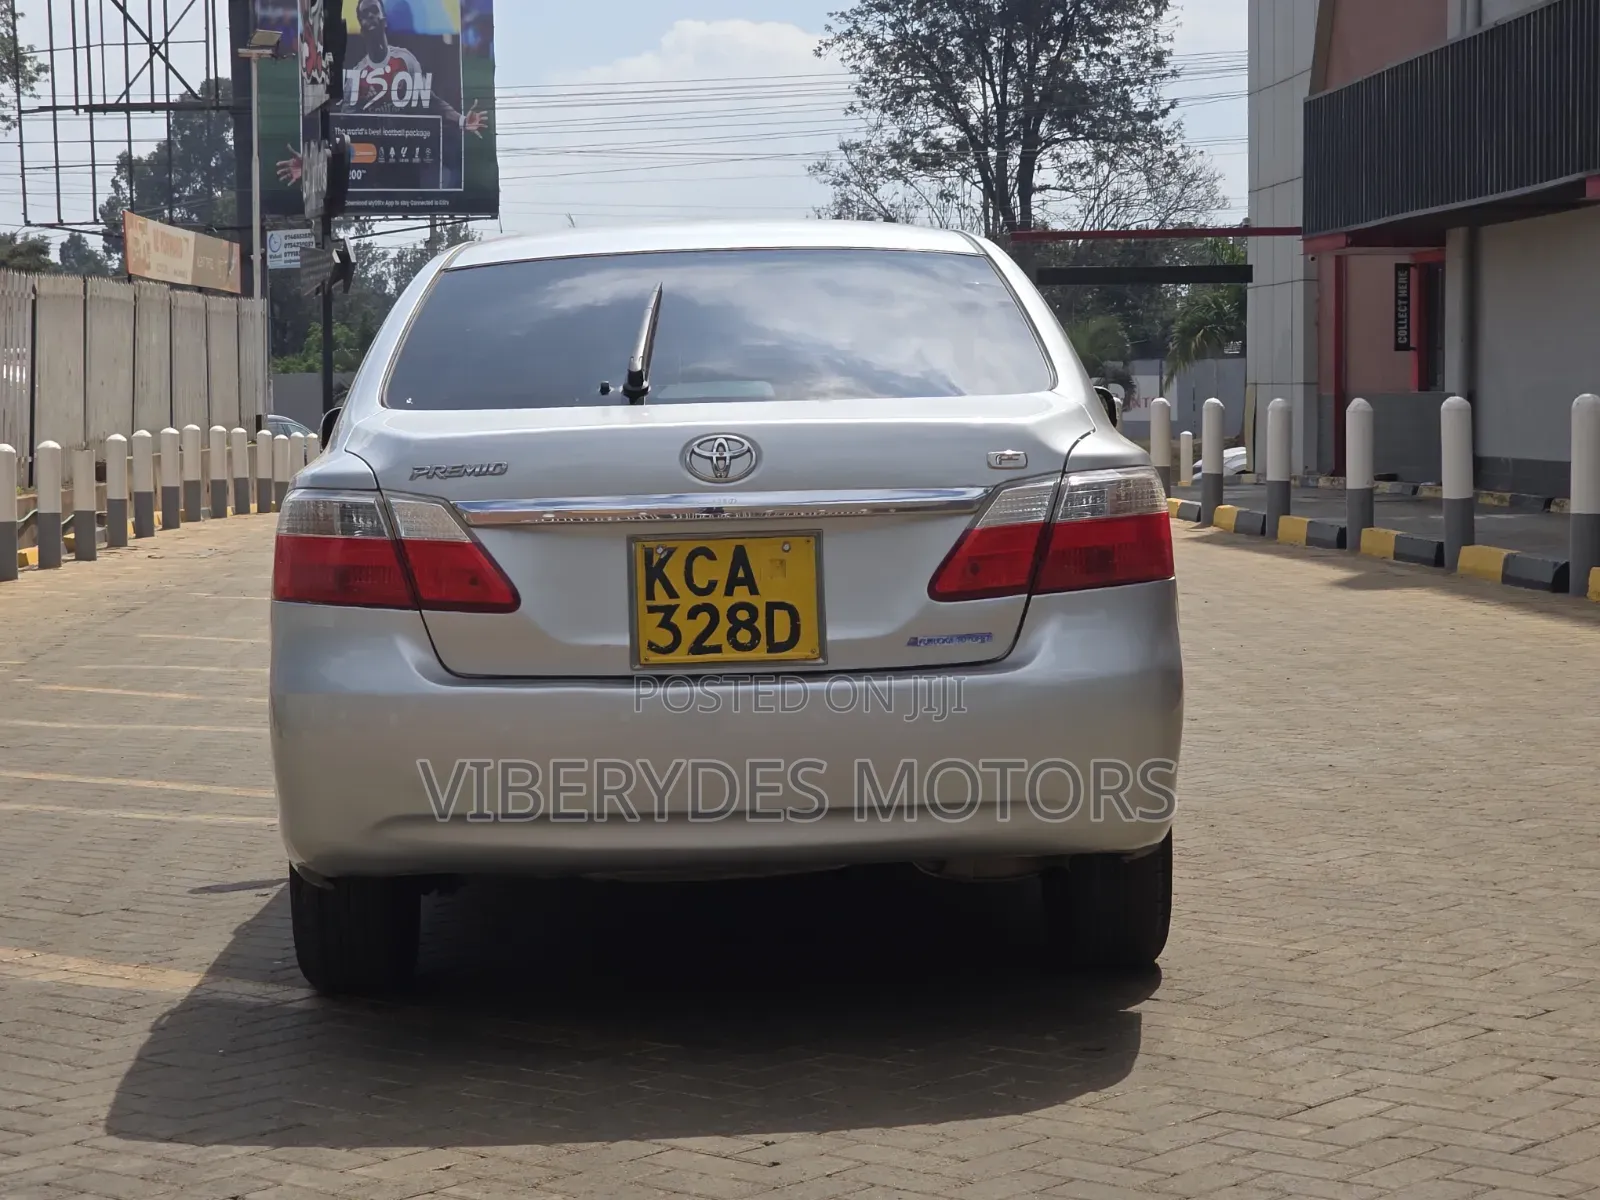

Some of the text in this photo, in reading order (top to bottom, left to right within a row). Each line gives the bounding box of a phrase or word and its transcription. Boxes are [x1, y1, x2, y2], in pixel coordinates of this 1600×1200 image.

[391, 71, 432, 108] ON
[405, 128, 431, 139] package
[1397, 270, 1408, 344] COLLECT HERE
[408, 461, 509, 481] PREMIO
[644, 544, 761, 601] KCA
[646, 601, 801, 656] 328D
